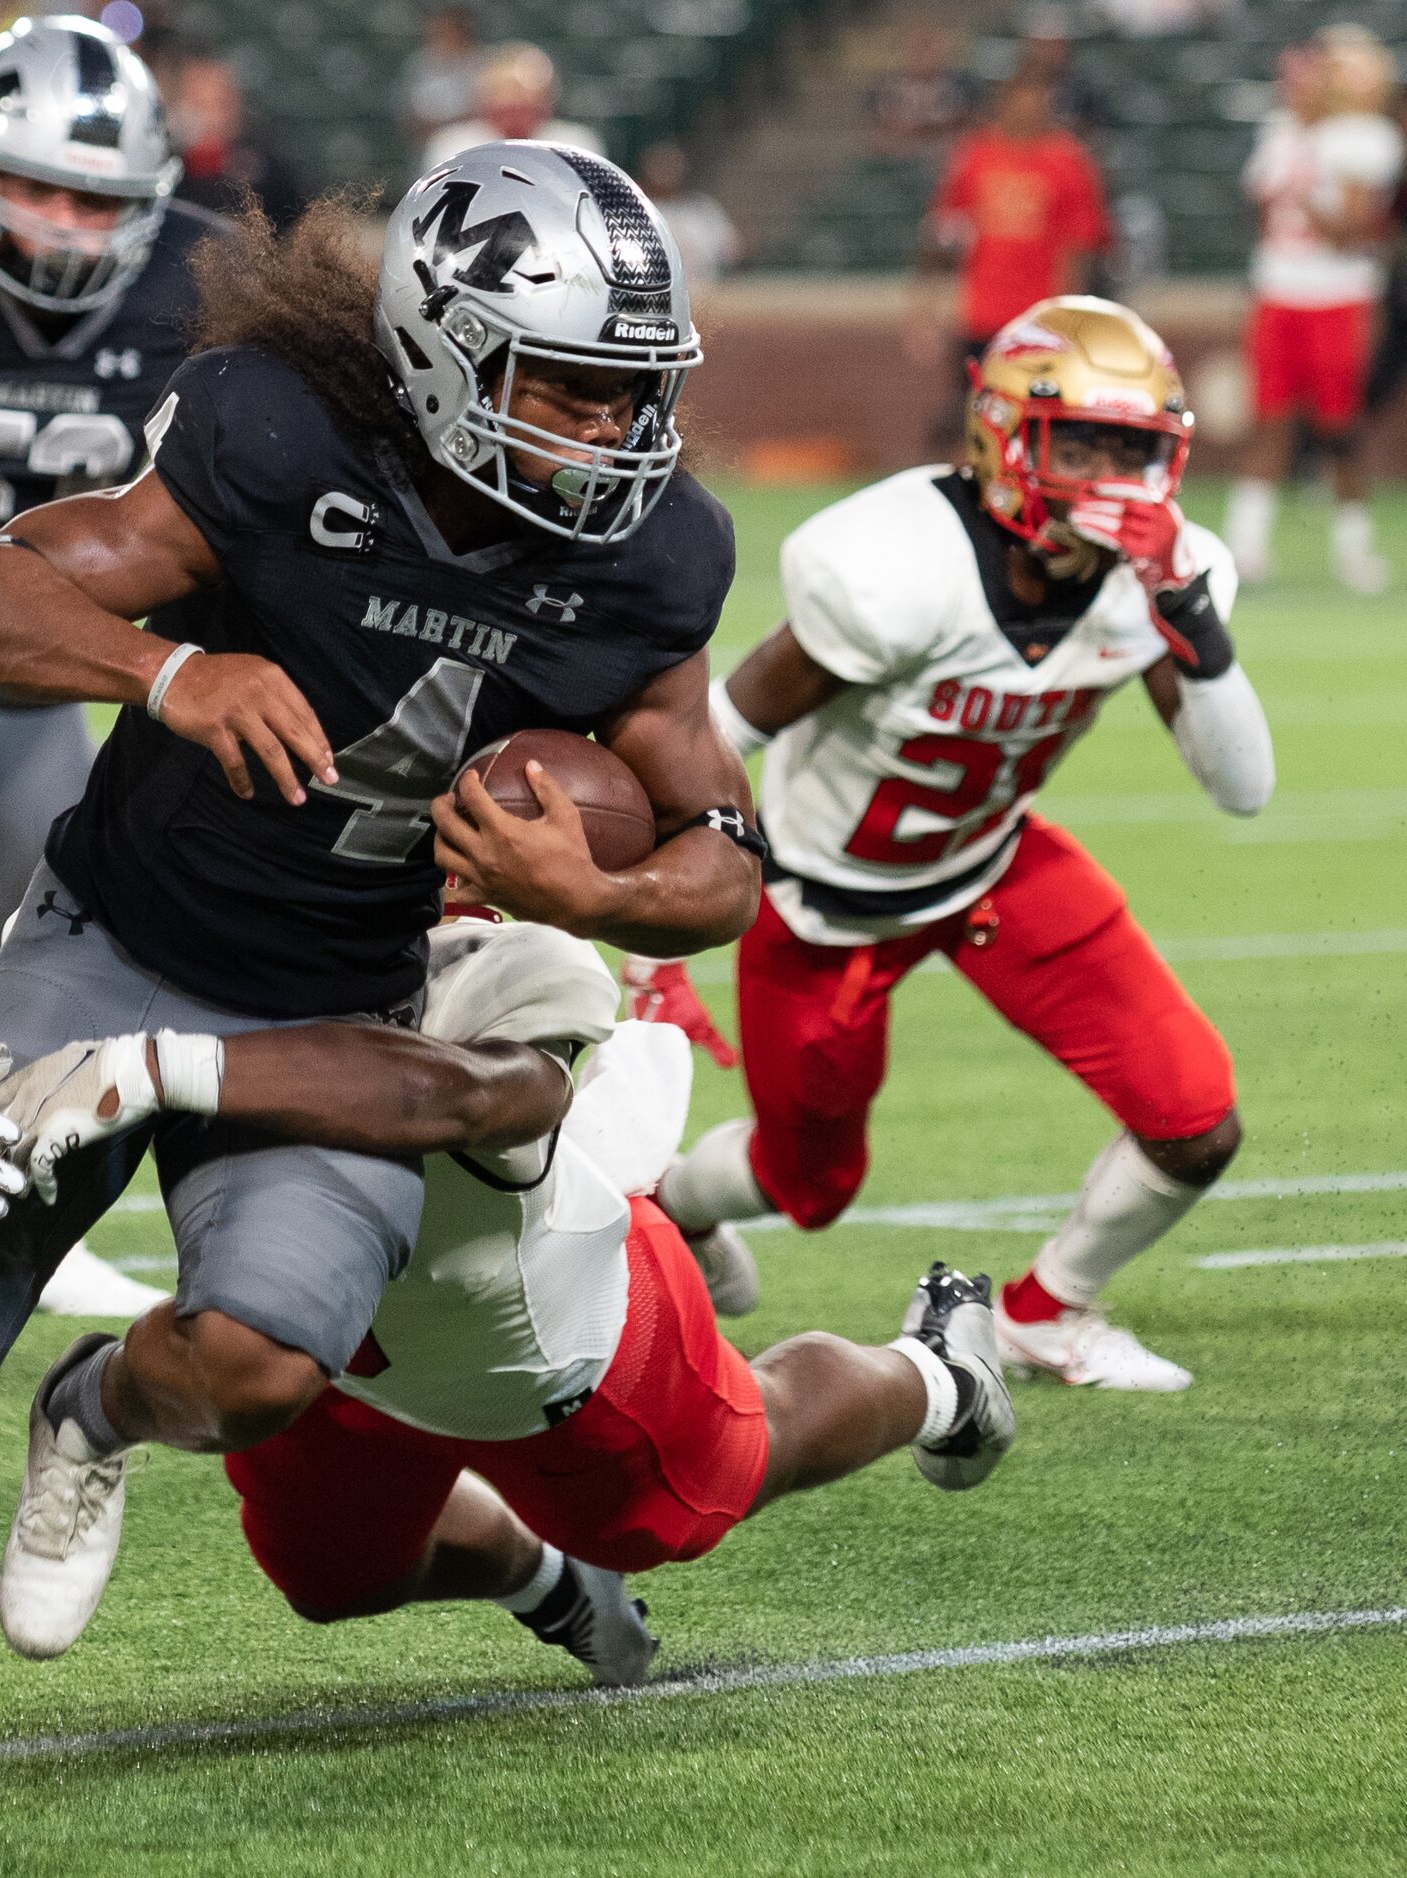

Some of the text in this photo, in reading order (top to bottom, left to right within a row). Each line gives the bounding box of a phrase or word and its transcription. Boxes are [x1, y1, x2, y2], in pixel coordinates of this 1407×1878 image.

[614, 322, 675, 341] Riddell
[360, 595, 518, 664] MARTIN
[308, 656, 486, 863] 4
